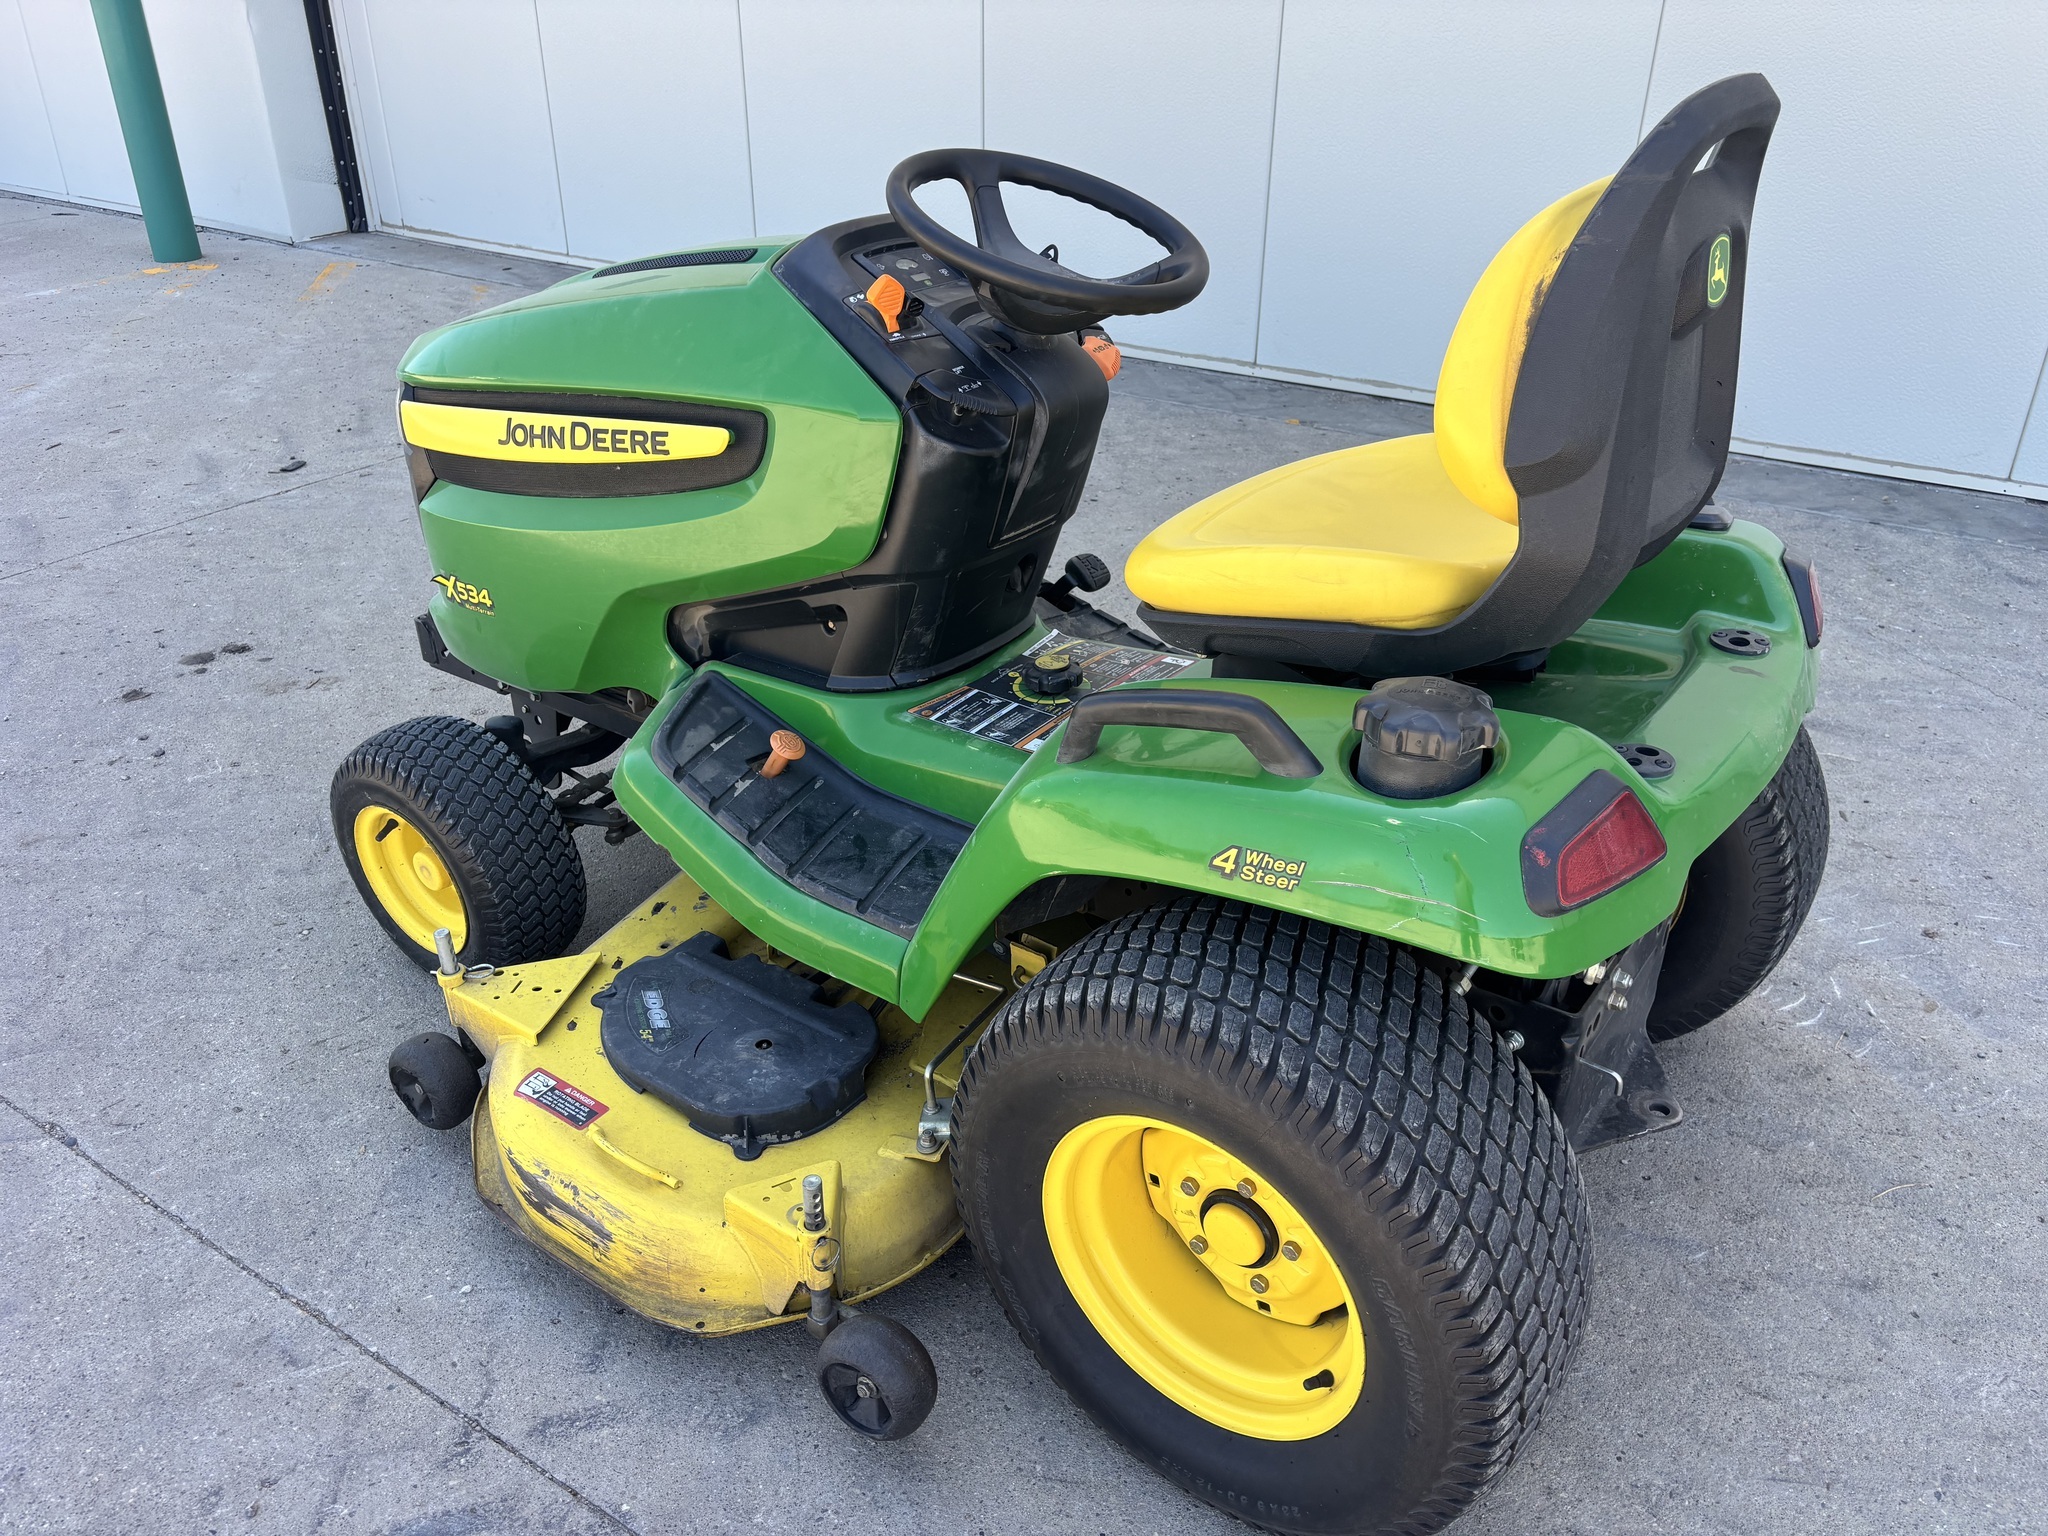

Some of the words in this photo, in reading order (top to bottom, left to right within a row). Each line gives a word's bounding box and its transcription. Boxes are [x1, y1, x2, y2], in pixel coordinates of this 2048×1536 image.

[498, 417, 566, 450] JOHN
[570, 421, 670, 456] DEERE
[431, 574, 494, 608] X534
[1211, 846, 1240, 876] 4
[1245, 849, 1306, 877] Wheel
[1240, 865, 1299, 891] Steer
[641, 989, 671, 1029] EDGE
[571, 1090, 596, 1107] DANGER
